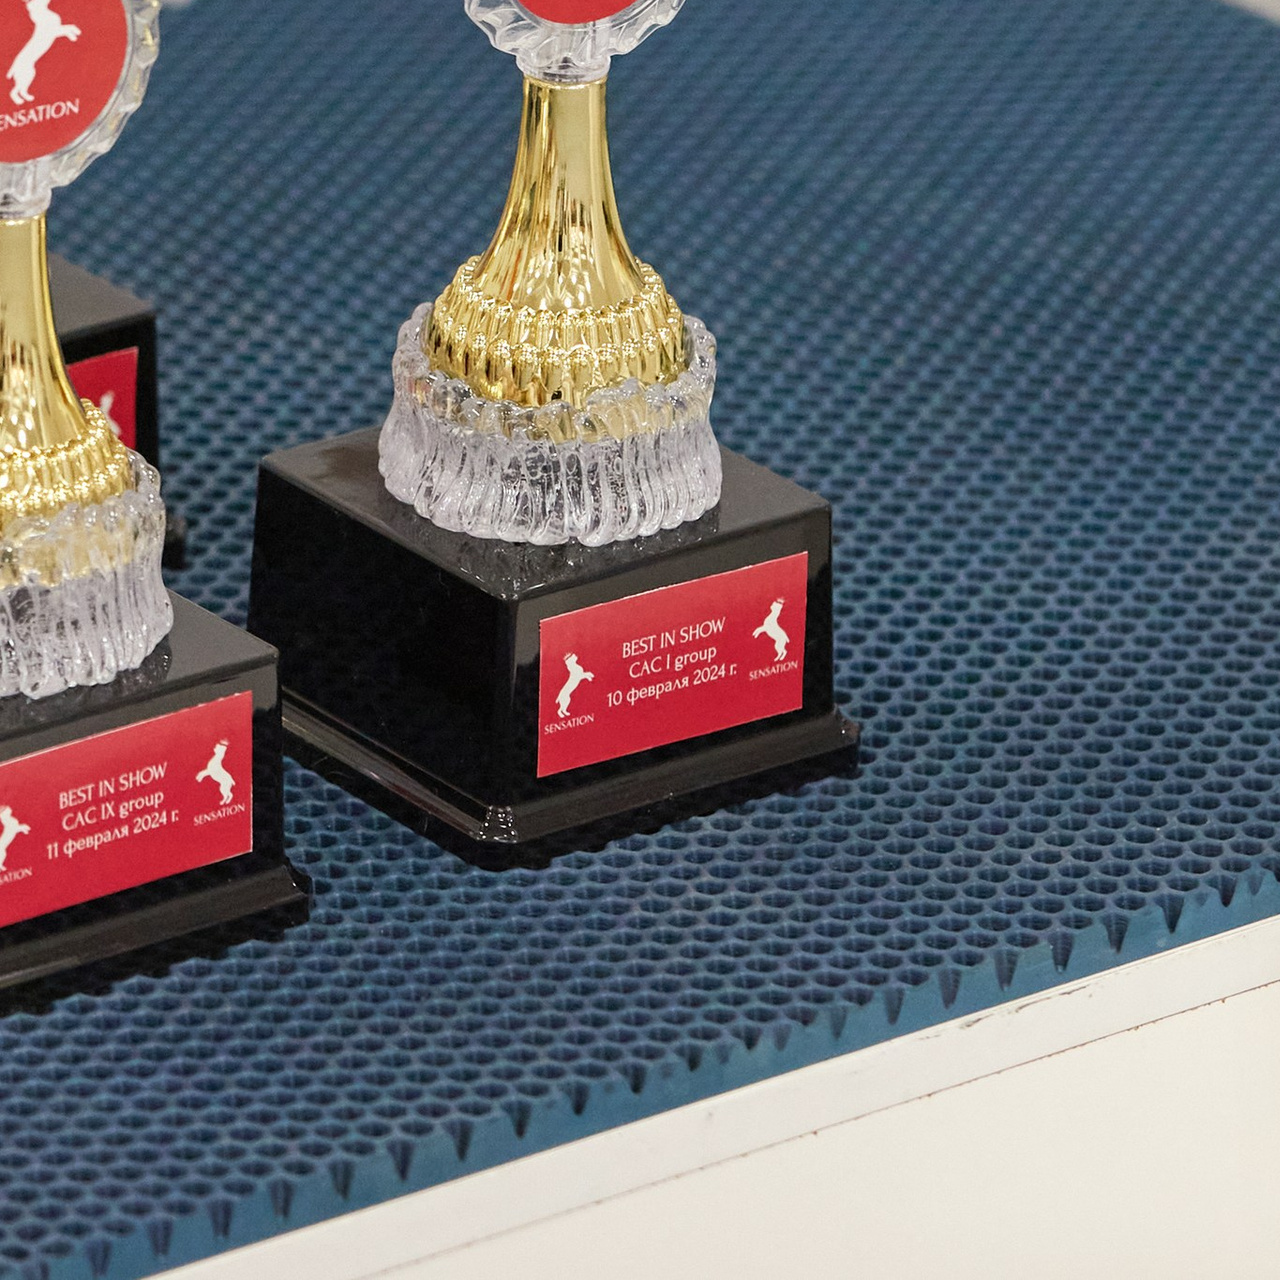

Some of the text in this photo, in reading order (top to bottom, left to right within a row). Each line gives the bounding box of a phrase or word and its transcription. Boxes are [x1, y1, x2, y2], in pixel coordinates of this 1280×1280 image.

[622, 616, 726, 659] BEST IN SHOW
[629, 656, 662, 678] CAC
[674, 646, 717, 671] group
[749, 660, 798, 681] SENSATION
[606, 663, 737, 707] 10 февраля 2024 г.
[544, 713, 595, 735] SENSATION
[59, 761, 167, 810] BEST IN SHOW
[62, 791, 164, 831] CAC IX group
[193, 804, 246, 826] SENSATION
[47, 809, 179, 860] 11 февраля 2024 г.
